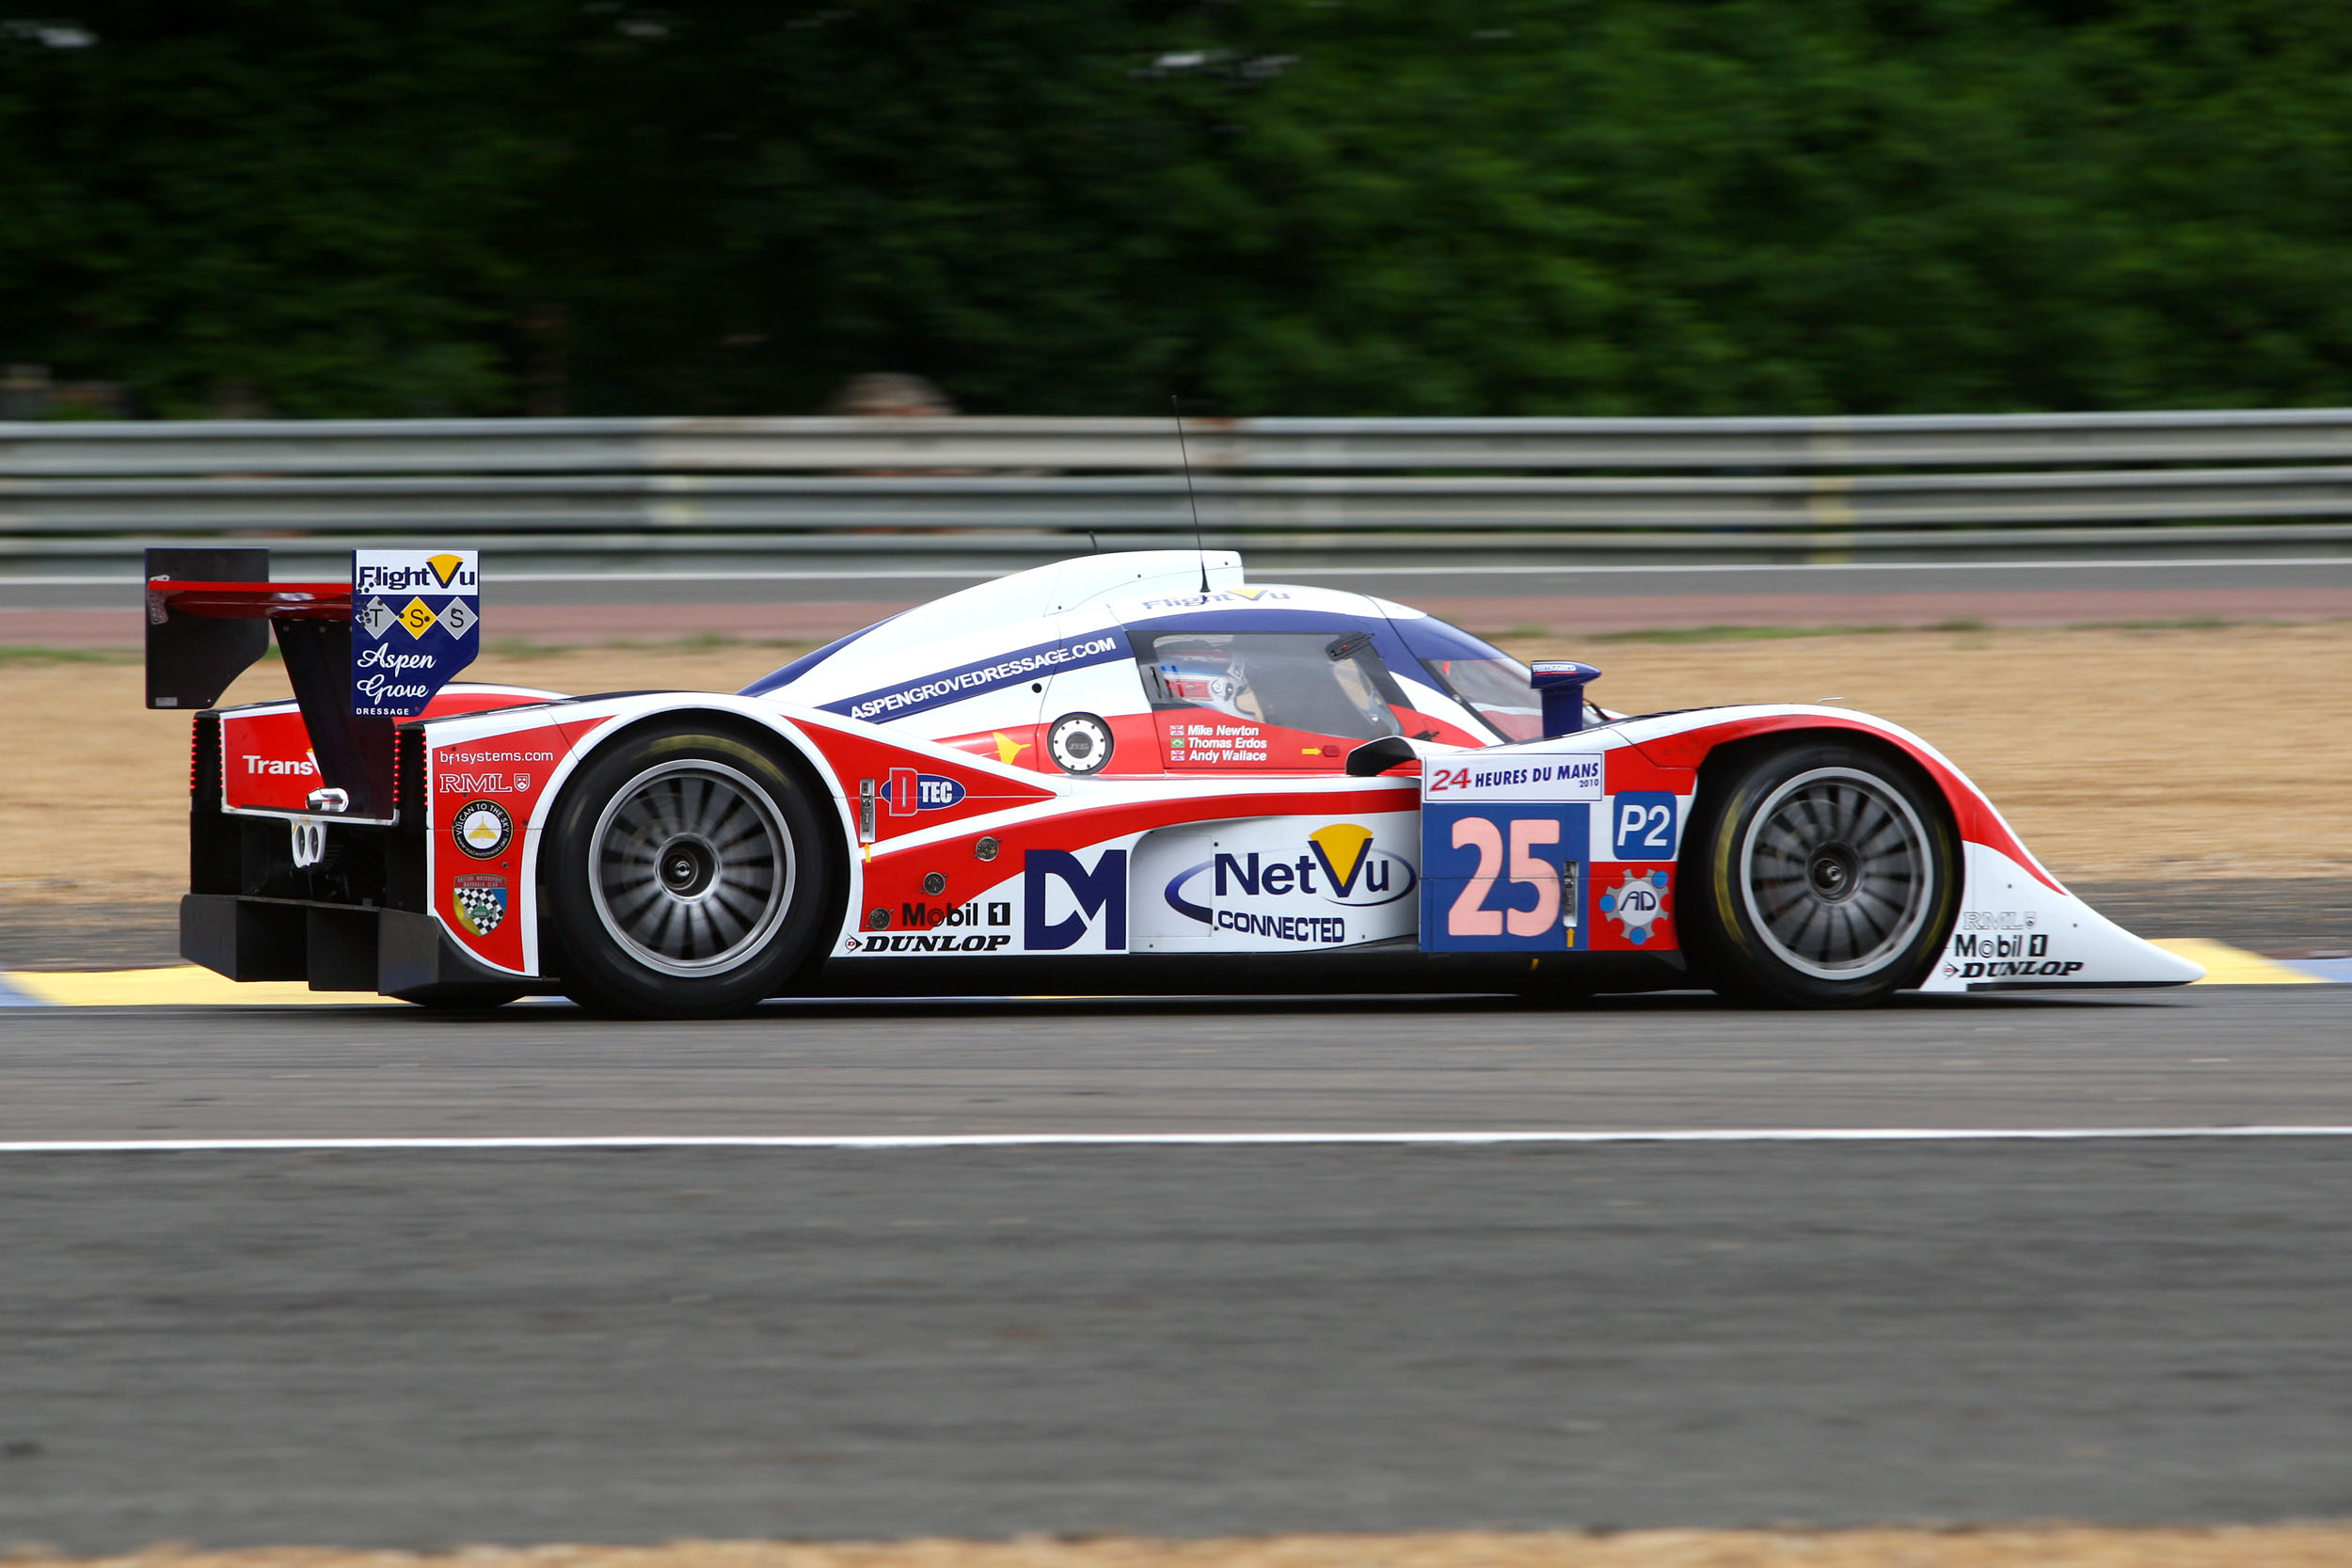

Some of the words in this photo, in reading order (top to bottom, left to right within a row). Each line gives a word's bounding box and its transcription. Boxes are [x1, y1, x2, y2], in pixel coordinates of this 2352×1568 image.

[358, 555, 475, 591] FlightVu
[370, 609, 383, 627] T
[410, 609, 424, 628] S
[450, 609, 465, 628] S
[358, 642, 437, 677] Aspen
[357, 673, 429, 705] Grove
[850, 637, 1117, 720] ASPENGROVEDRESSAGE.COM
[1187, 725, 1213, 736] Mike
[1216, 724, 1259, 736] Newton
[1187, 737, 1232, 749] Thomas
[1234, 737, 1267, 749] Erdos
[439, 751, 554, 765] bf1systems.com
[1188, 750, 1220, 764] Andy
[1221, 750, 1267, 761] Wallace
[439, 772, 513, 793] RML
[1430, 768, 1471, 792] 24
[1475, 768, 1528, 788] HEURES
[1533, 767, 1552, 783] DU
[1557, 762, 1599, 781] MANS
[1580, 779, 1599, 788] 2010
[455, 806, 475, 836] VULCAN
[489, 804, 503, 817] THE
[501, 817, 510, 832] SKY
[1616, 804, 1671, 847] P2
[1215, 825, 1390, 898] NetVu
[1448, 816, 1561, 937] 25
[1025, 849, 1127, 950] DM
[902, 902, 978, 927] Mobil
[990, 904, 1008, 925] 1
[1218, 911, 1344, 942] CONNECTED
[1963, 911, 2024, 930] RML
[862, 935, 1011, 952] DUNLOP
[1955, 934, 2023, 958] Mobil
[2029, 935, 2046, 956] 1
[1960, 961, 2084, 977] DUNLOP
